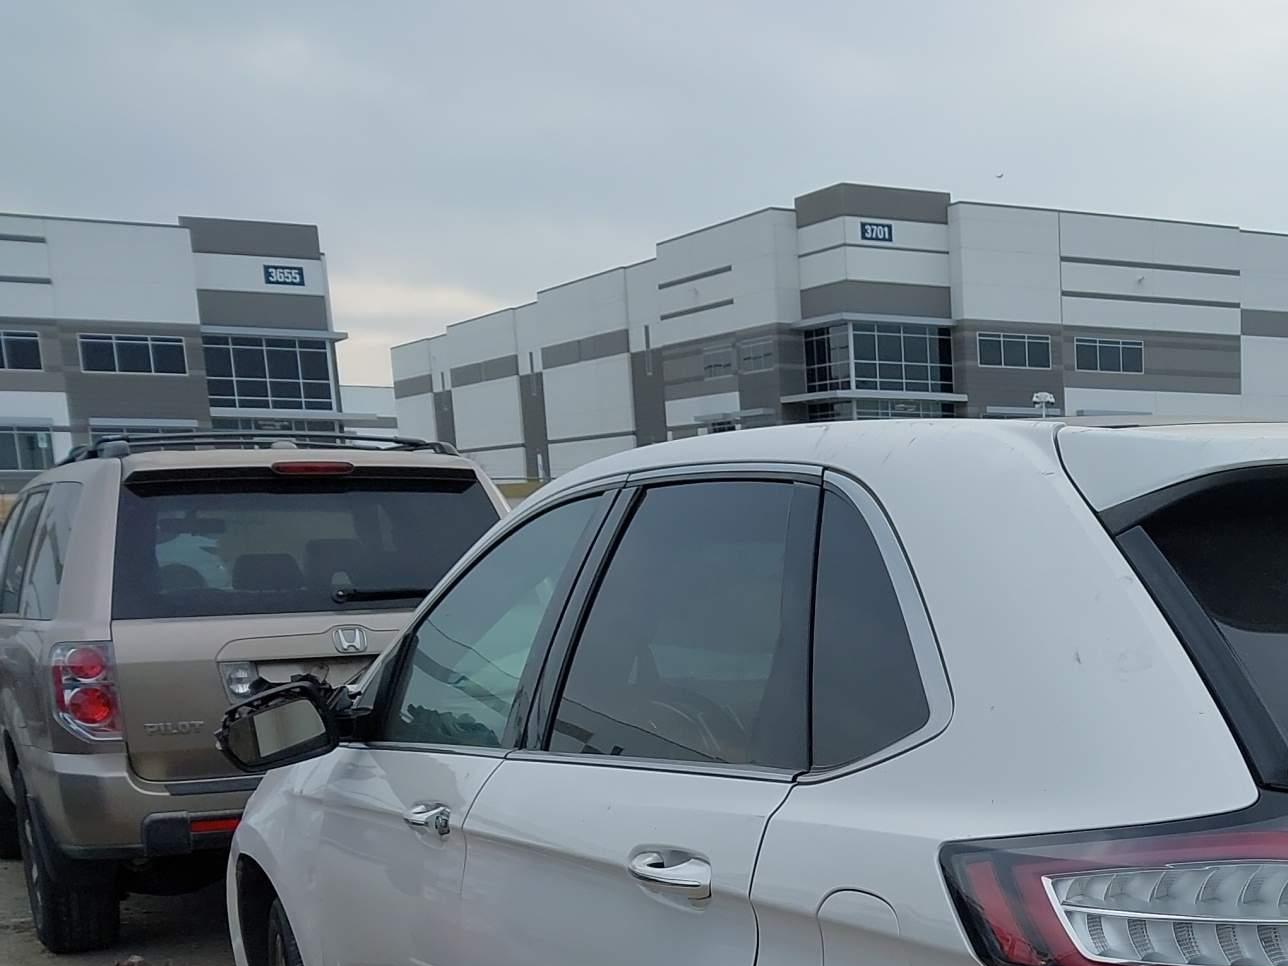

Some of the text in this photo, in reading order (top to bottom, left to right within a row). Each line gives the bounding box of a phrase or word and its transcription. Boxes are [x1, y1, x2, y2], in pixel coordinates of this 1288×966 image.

[865, 224, 889, 239] 3701
[268, 268, 300, 283] 3655
[143, 720, 204, 737] PILOT
